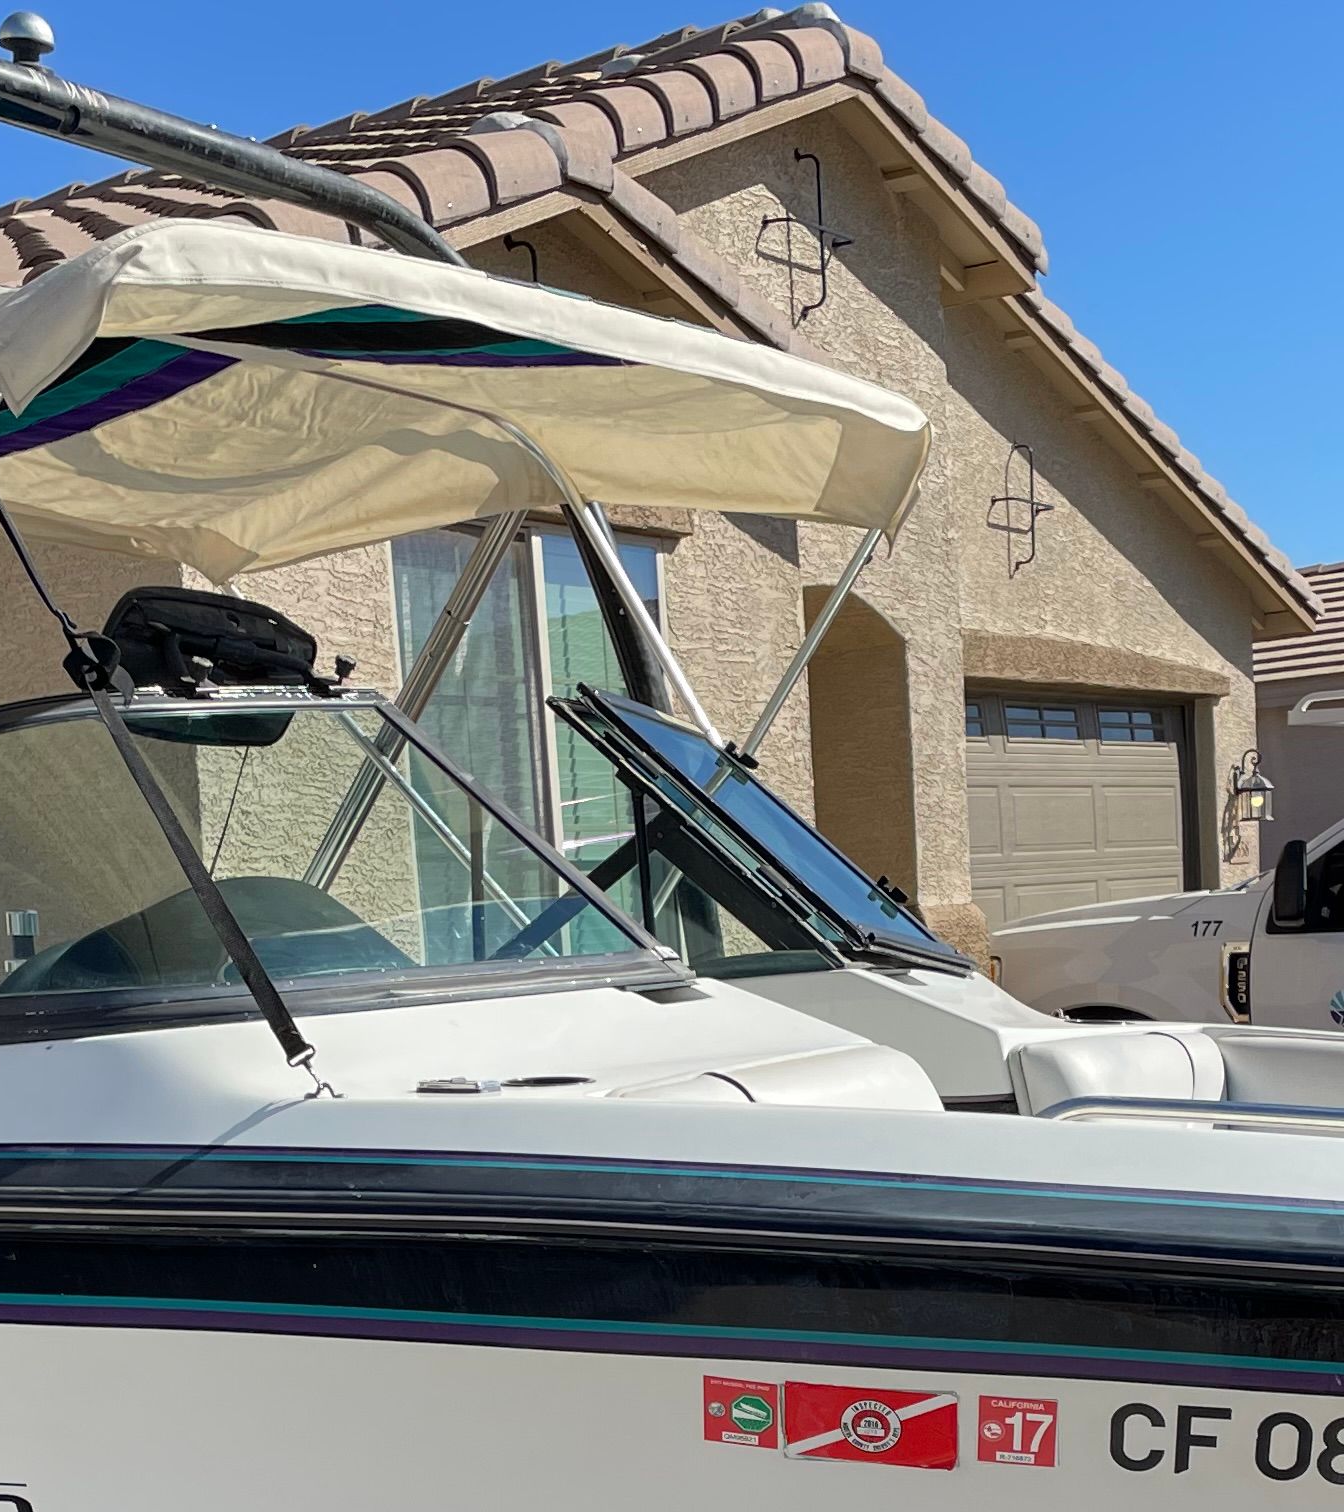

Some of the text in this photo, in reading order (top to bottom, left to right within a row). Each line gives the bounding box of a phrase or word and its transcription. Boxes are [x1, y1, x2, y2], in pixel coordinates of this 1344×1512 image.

[1191, 920, 1223, 937] 177
[991, 1399, 1045, 1411] CALIFORNIA
[1004, 1411, 1054, 1454] 17
[1109, 1402, 1232, 1474] CF
